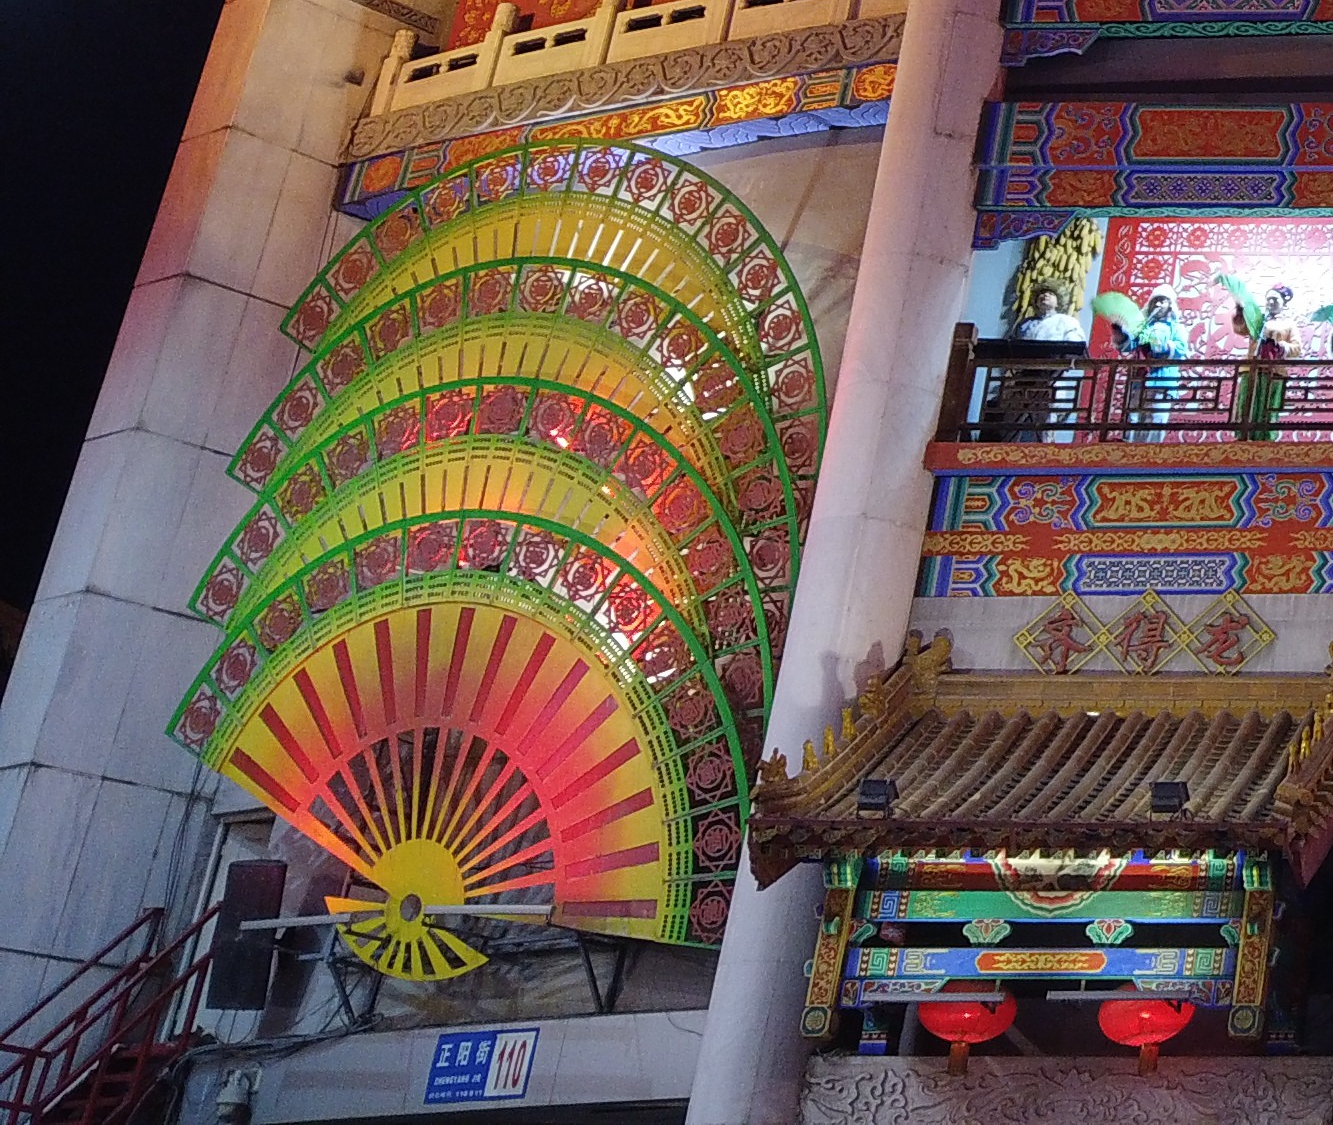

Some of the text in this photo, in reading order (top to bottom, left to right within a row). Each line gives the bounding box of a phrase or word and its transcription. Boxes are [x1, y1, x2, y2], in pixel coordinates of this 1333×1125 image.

[436, 1040, 491, 1068] 正阳街
[493, 1039, 528, 1090] 110
